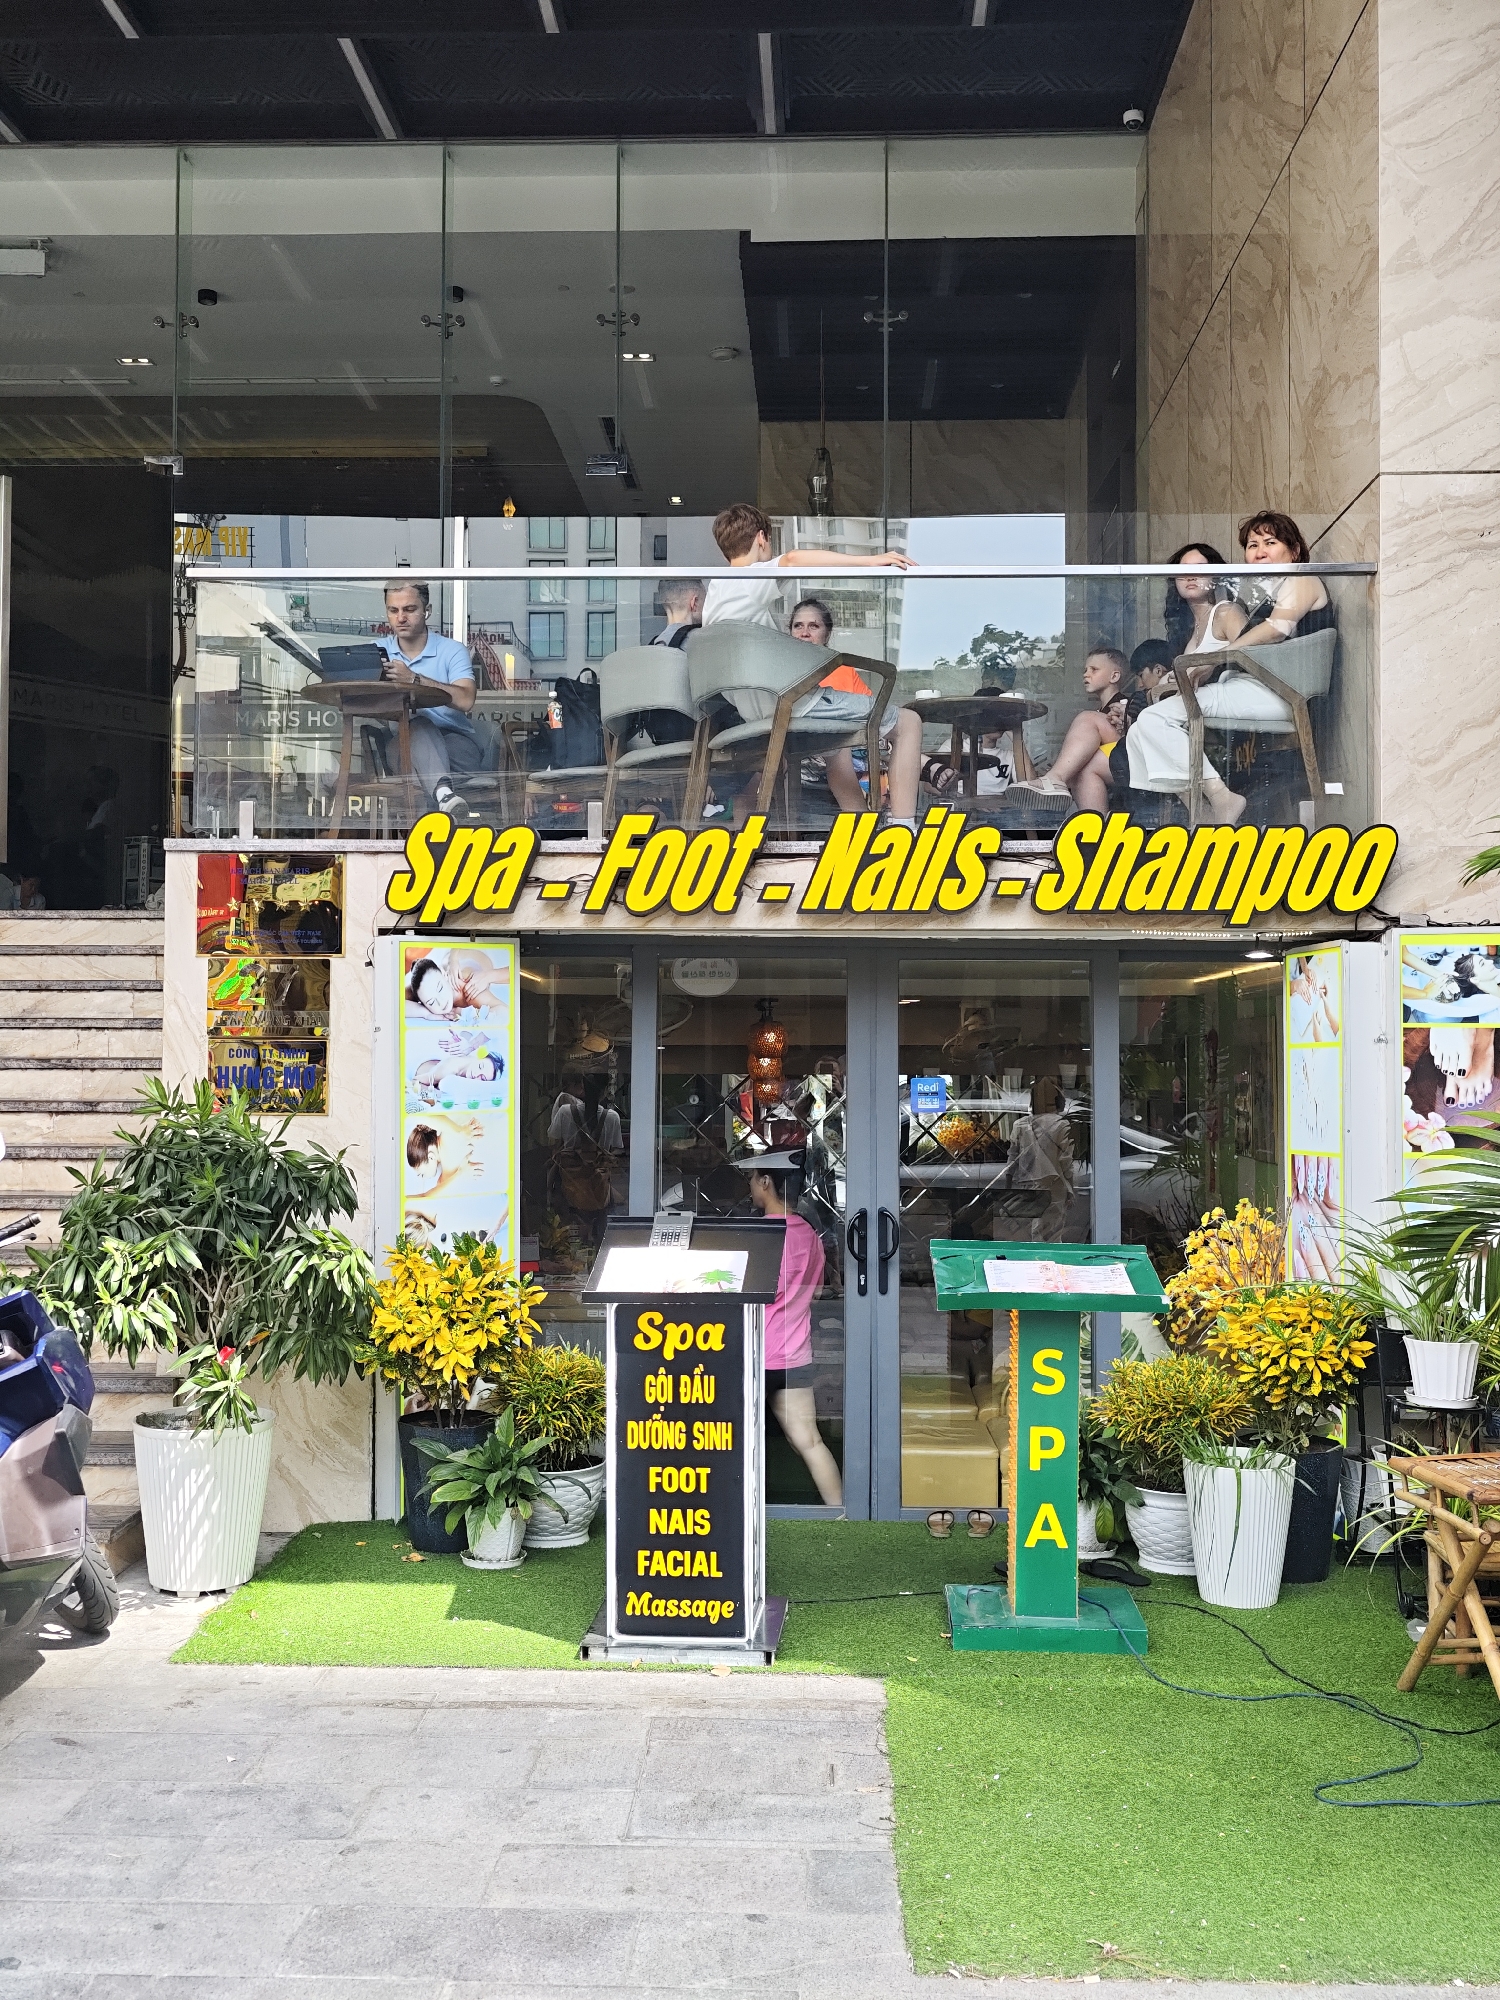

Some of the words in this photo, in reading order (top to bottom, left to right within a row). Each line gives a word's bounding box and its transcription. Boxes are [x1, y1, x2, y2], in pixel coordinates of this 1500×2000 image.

[235, 711, 300, 727] MARIS
[140, 848, 148, 904] ИНФОРМАЦИ
[385, 811, 537, 925] Spa
[584, 812, 768, 913] Foot
[800, 805, 1002, 913] Nails
[1034, 811, 1399, 926] Shampoo
[228, 1046, 259, 1059] CÔNG
[262, 1048, 274, 1058] TY
[217, 1064, 275, 1090] HƯNG
[283, 1064, 317, 1090] MƠ
[633, 1311, 726, 1361] Spa
[644, 1365, 674, 1412] GỘI
[679, 1364, 716, 1404] ĐẦU
[626, 1413, 687, 1451] DƯỠNG
[692, 1421, 733, 1451] SINH
[1024, 1348, 1068, 1549] SPA
[648, 1466, 711, 1494] FOOT
[649, 1508, 711, 1536] NAIS
[637, 1549, 723, 1578] FACIAL
[625, 1591, 735, 1623] Massage
